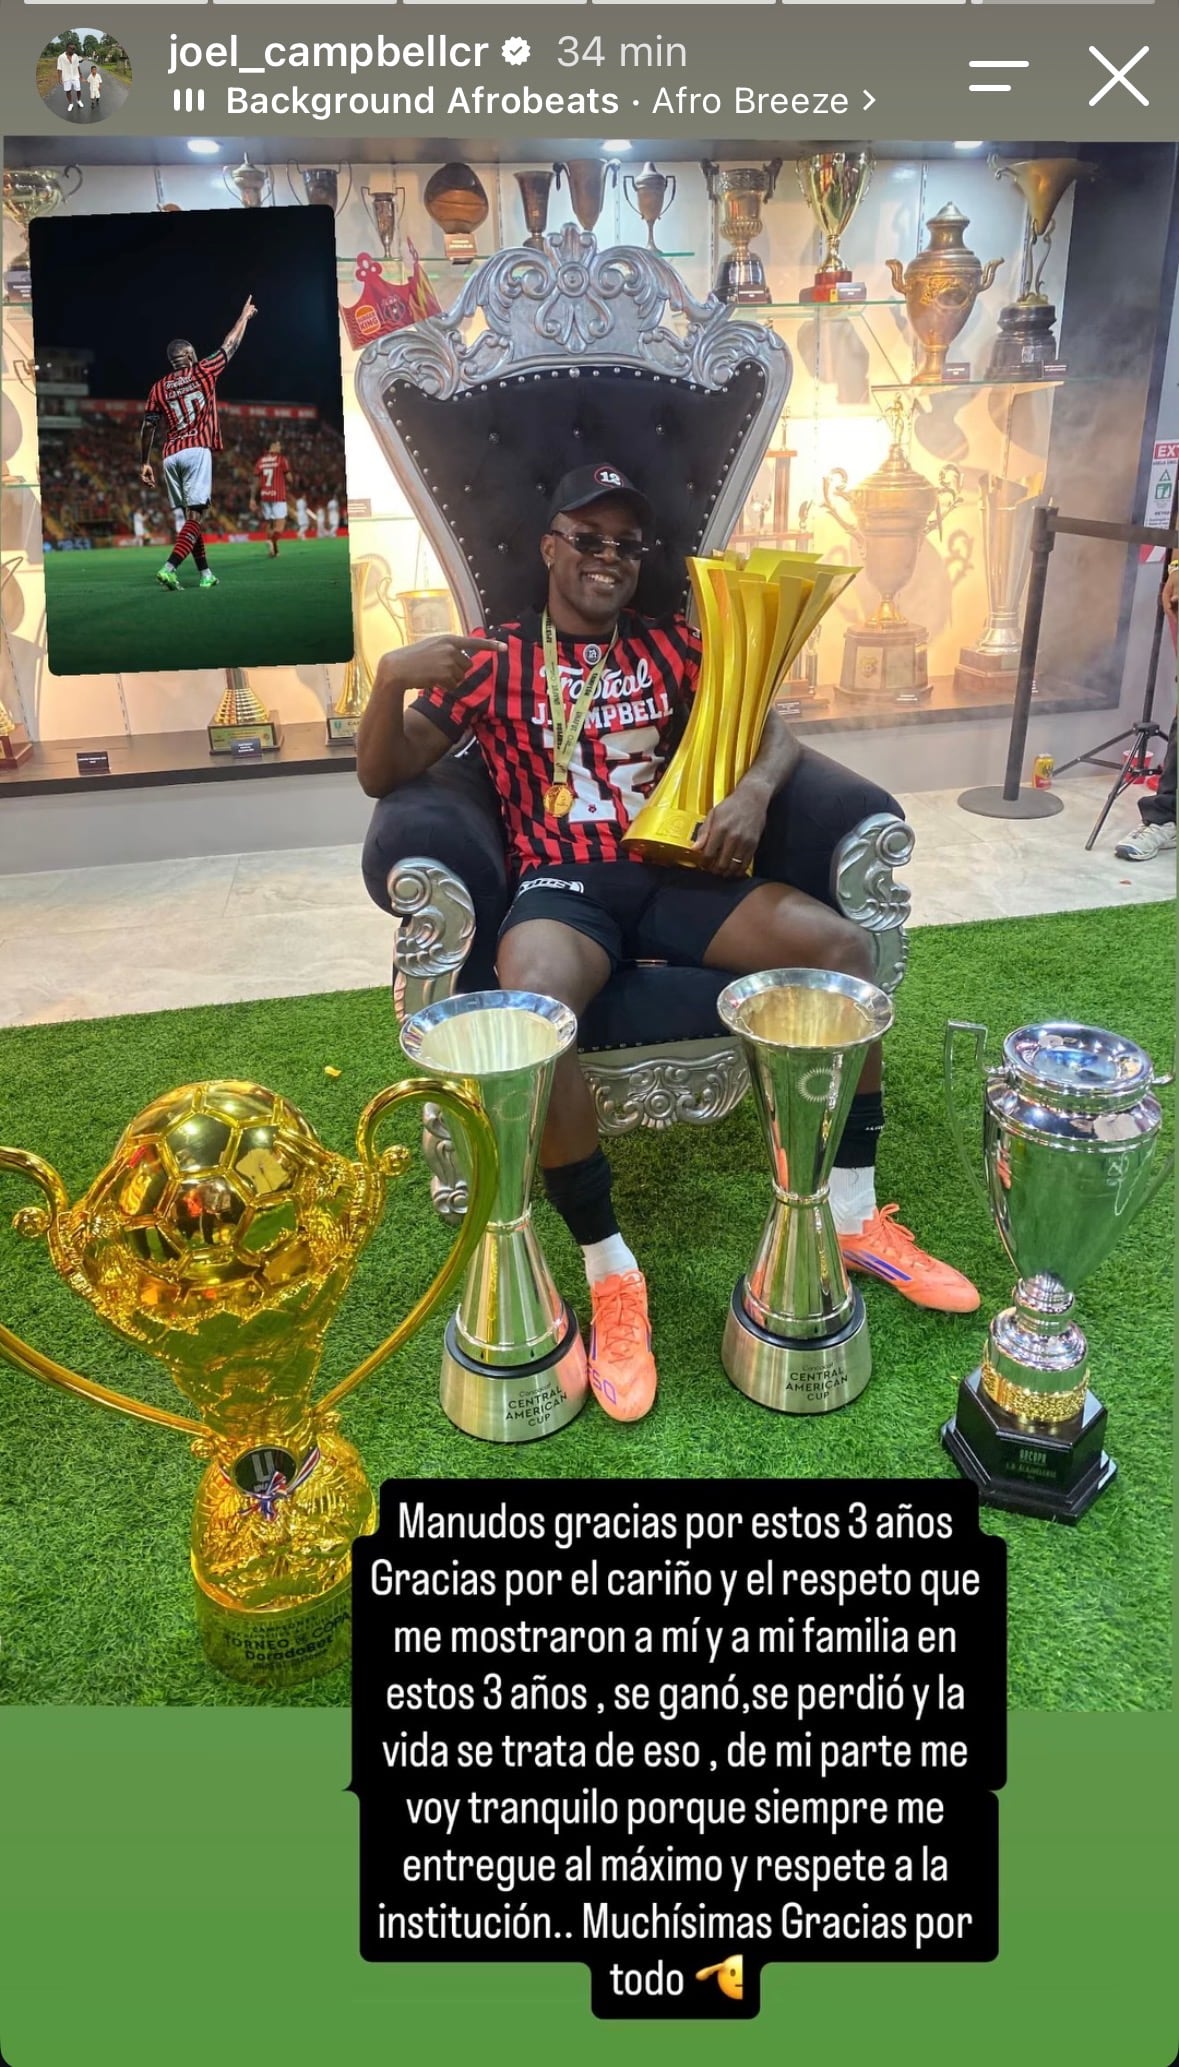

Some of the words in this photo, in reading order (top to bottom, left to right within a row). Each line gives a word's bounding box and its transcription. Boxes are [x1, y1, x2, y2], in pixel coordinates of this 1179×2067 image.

[262, 468, 274, 487] 7
[600, 471, 621, 486] 12
[531, 693, 673, 730] J.MPBELL
[785, 1374, 848, 1392] AMERICAN
[789, 1367, 844, 1382] CENTRAL
[508, 1386, 562, 1409] CENTRAL
[807, 1391, 830, 1401] CUP
[505, 1391, 567, 1420] AMERICAN
[528, 1413, 551, 1427] CUP
[311, 1611, 350, 1639] COPA
